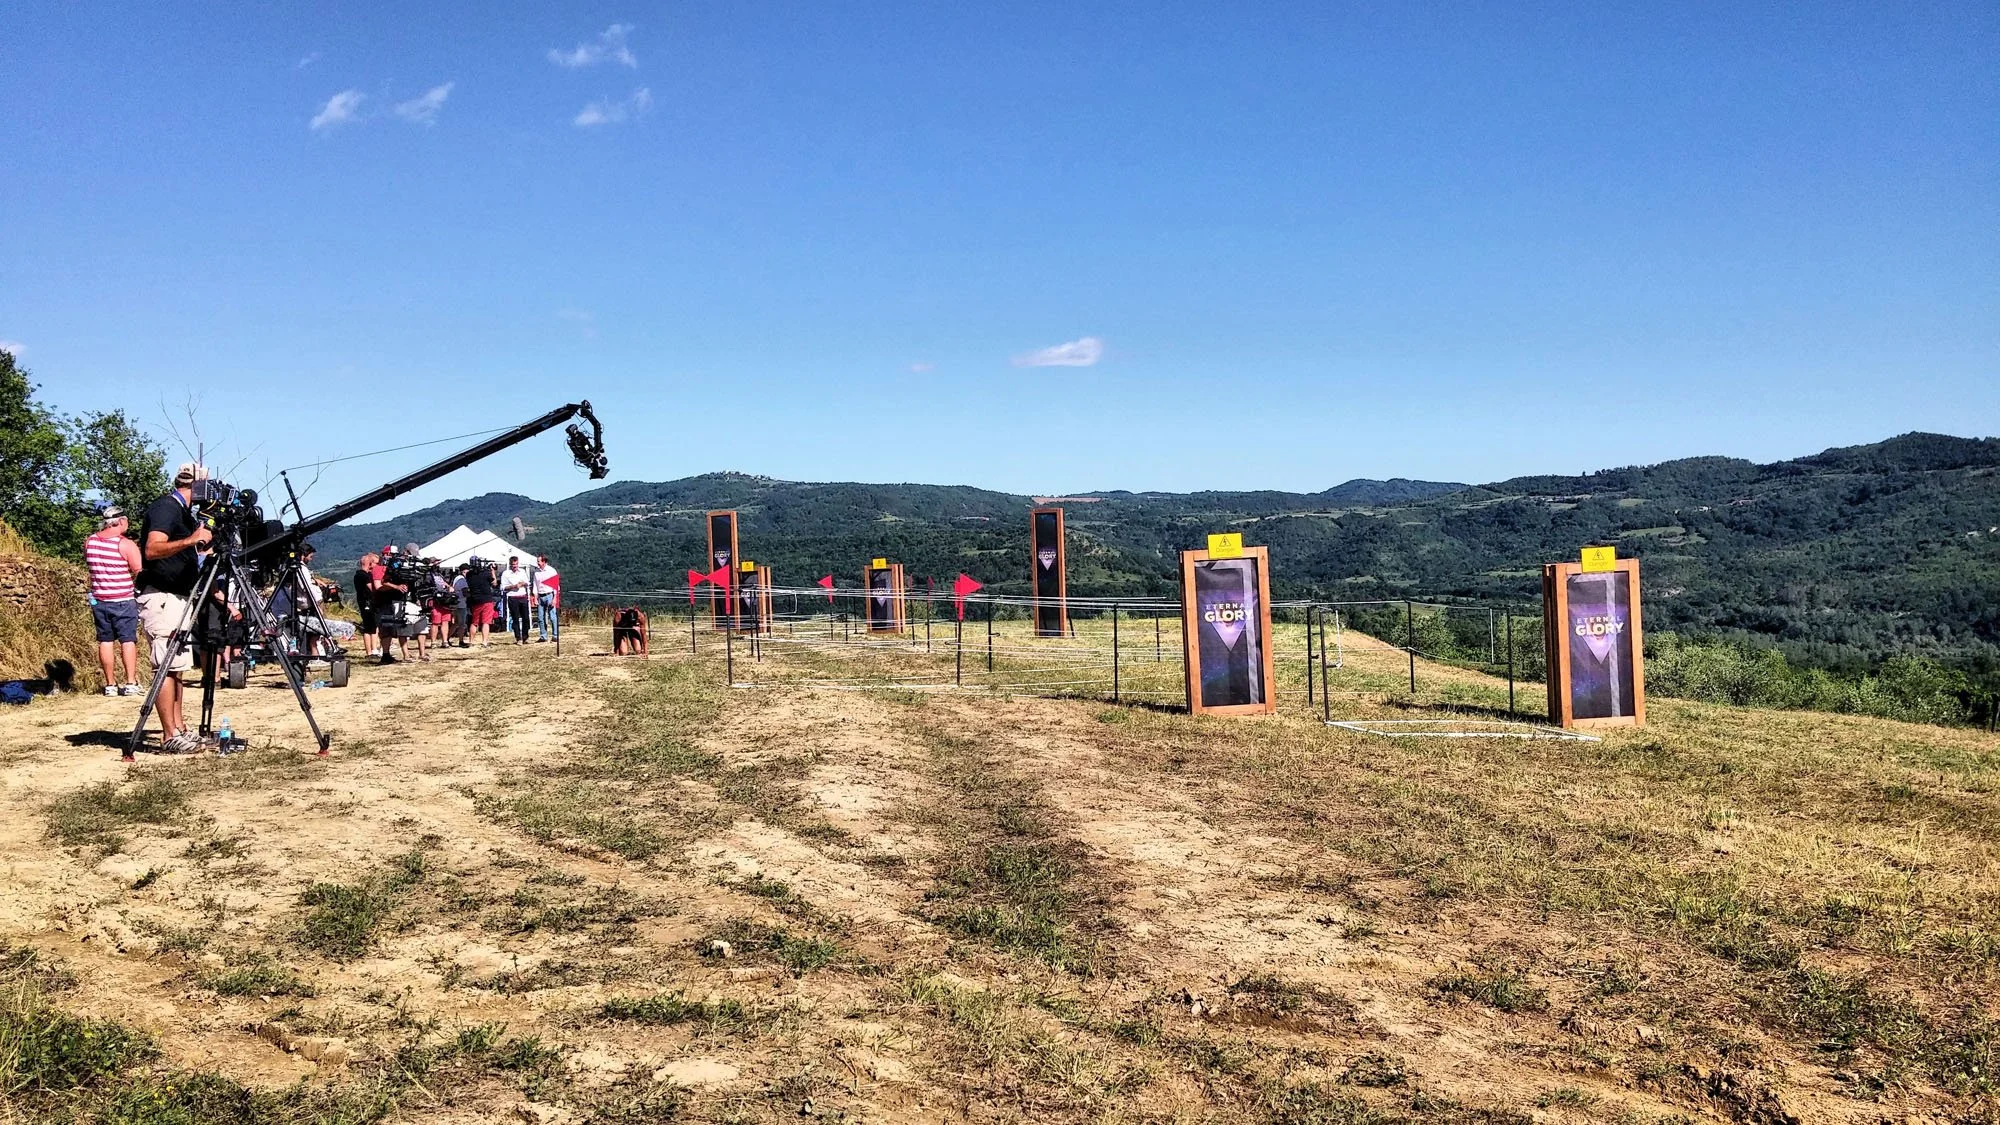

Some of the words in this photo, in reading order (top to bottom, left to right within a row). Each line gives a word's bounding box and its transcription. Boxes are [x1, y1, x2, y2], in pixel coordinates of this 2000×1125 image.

[1204, 609, 1252, 622] GLORY
[1577, 615, 1622, 624] ETERNAL
[1575, 622, 1624, 636] GLORY
